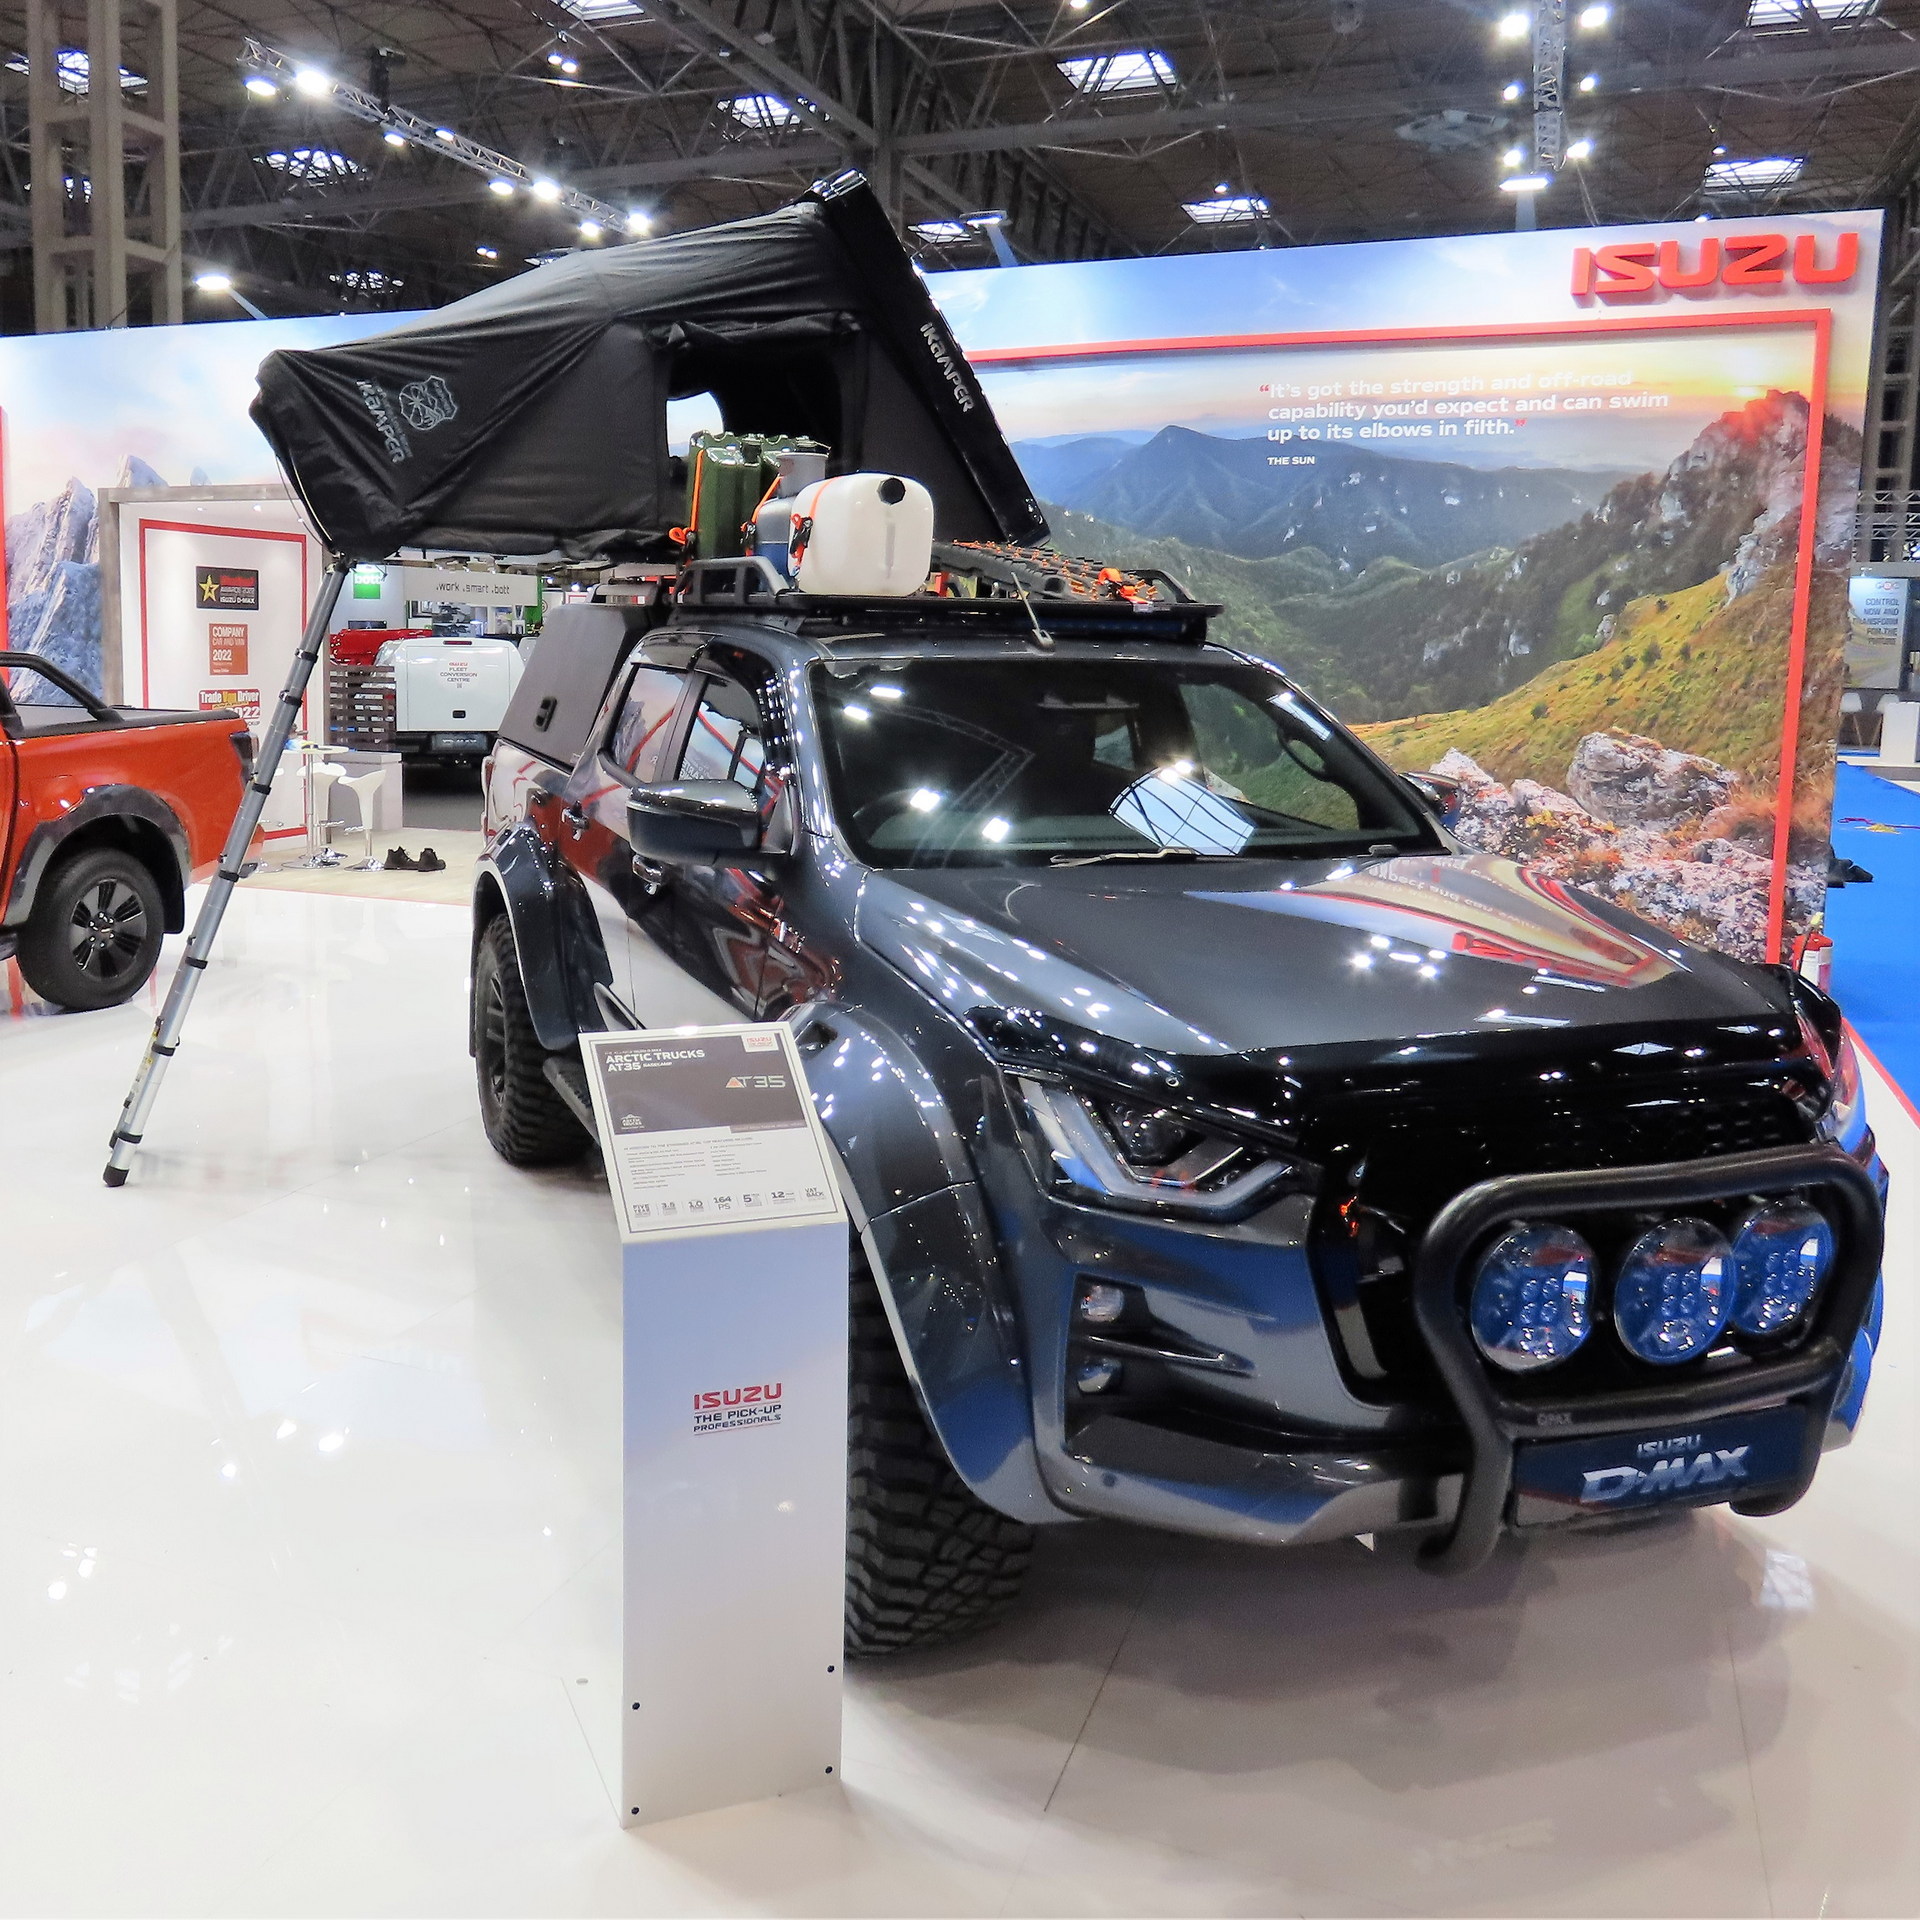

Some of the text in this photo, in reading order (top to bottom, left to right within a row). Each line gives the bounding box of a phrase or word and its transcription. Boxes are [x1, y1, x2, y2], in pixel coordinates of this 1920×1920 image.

[1570, 232, 1858, 296] ISUZU
[1308, 381, 1342, 400] got
[1350, 380, 1384, 396] the
[1390, 376, 1484, 396] strength
[1491, 374, 1533, 390] and
[1538, 370, 1634, 388] off-road
[1268, 392, 1669, 422] capability you’d expect and can swim
[1267, 428, 1293, 444] up
[1299, 425, 1320, 440] to
[1326, 423, 1354, 440] its
[1359, 422, 1432, 438] elbows
[1439, 420, 1458, 436] in
[1267, 456, 1316, 466] THE SUN
[1865, 598, 1899, 606] CONTROL
[212, 626, 244, 638] COMPANY
[213, 650, 232, 661] 2022
[200, 692, 222, 703] Trade
[237, 690, 259, 702] Driver
[606, 1052, 652, 1064] ARCTIC
[656, 1049, 705, 1060] TRUCKS
[608, 1062, 642, 1072] AT35
[726, 1075, 786, 1088] AT35
[743, 1194, 752, 1203] 5
[694, 1382, 782, 1410] ISUZU
[694, 1404, 782, 1424] THE PICK-UP
[694, 1414, 781, 1432] PROFESSIONALS
[1636, 1434, 1702, 1458] ISUZU
[1580, 1444, 1750, 1504] D-MAX
